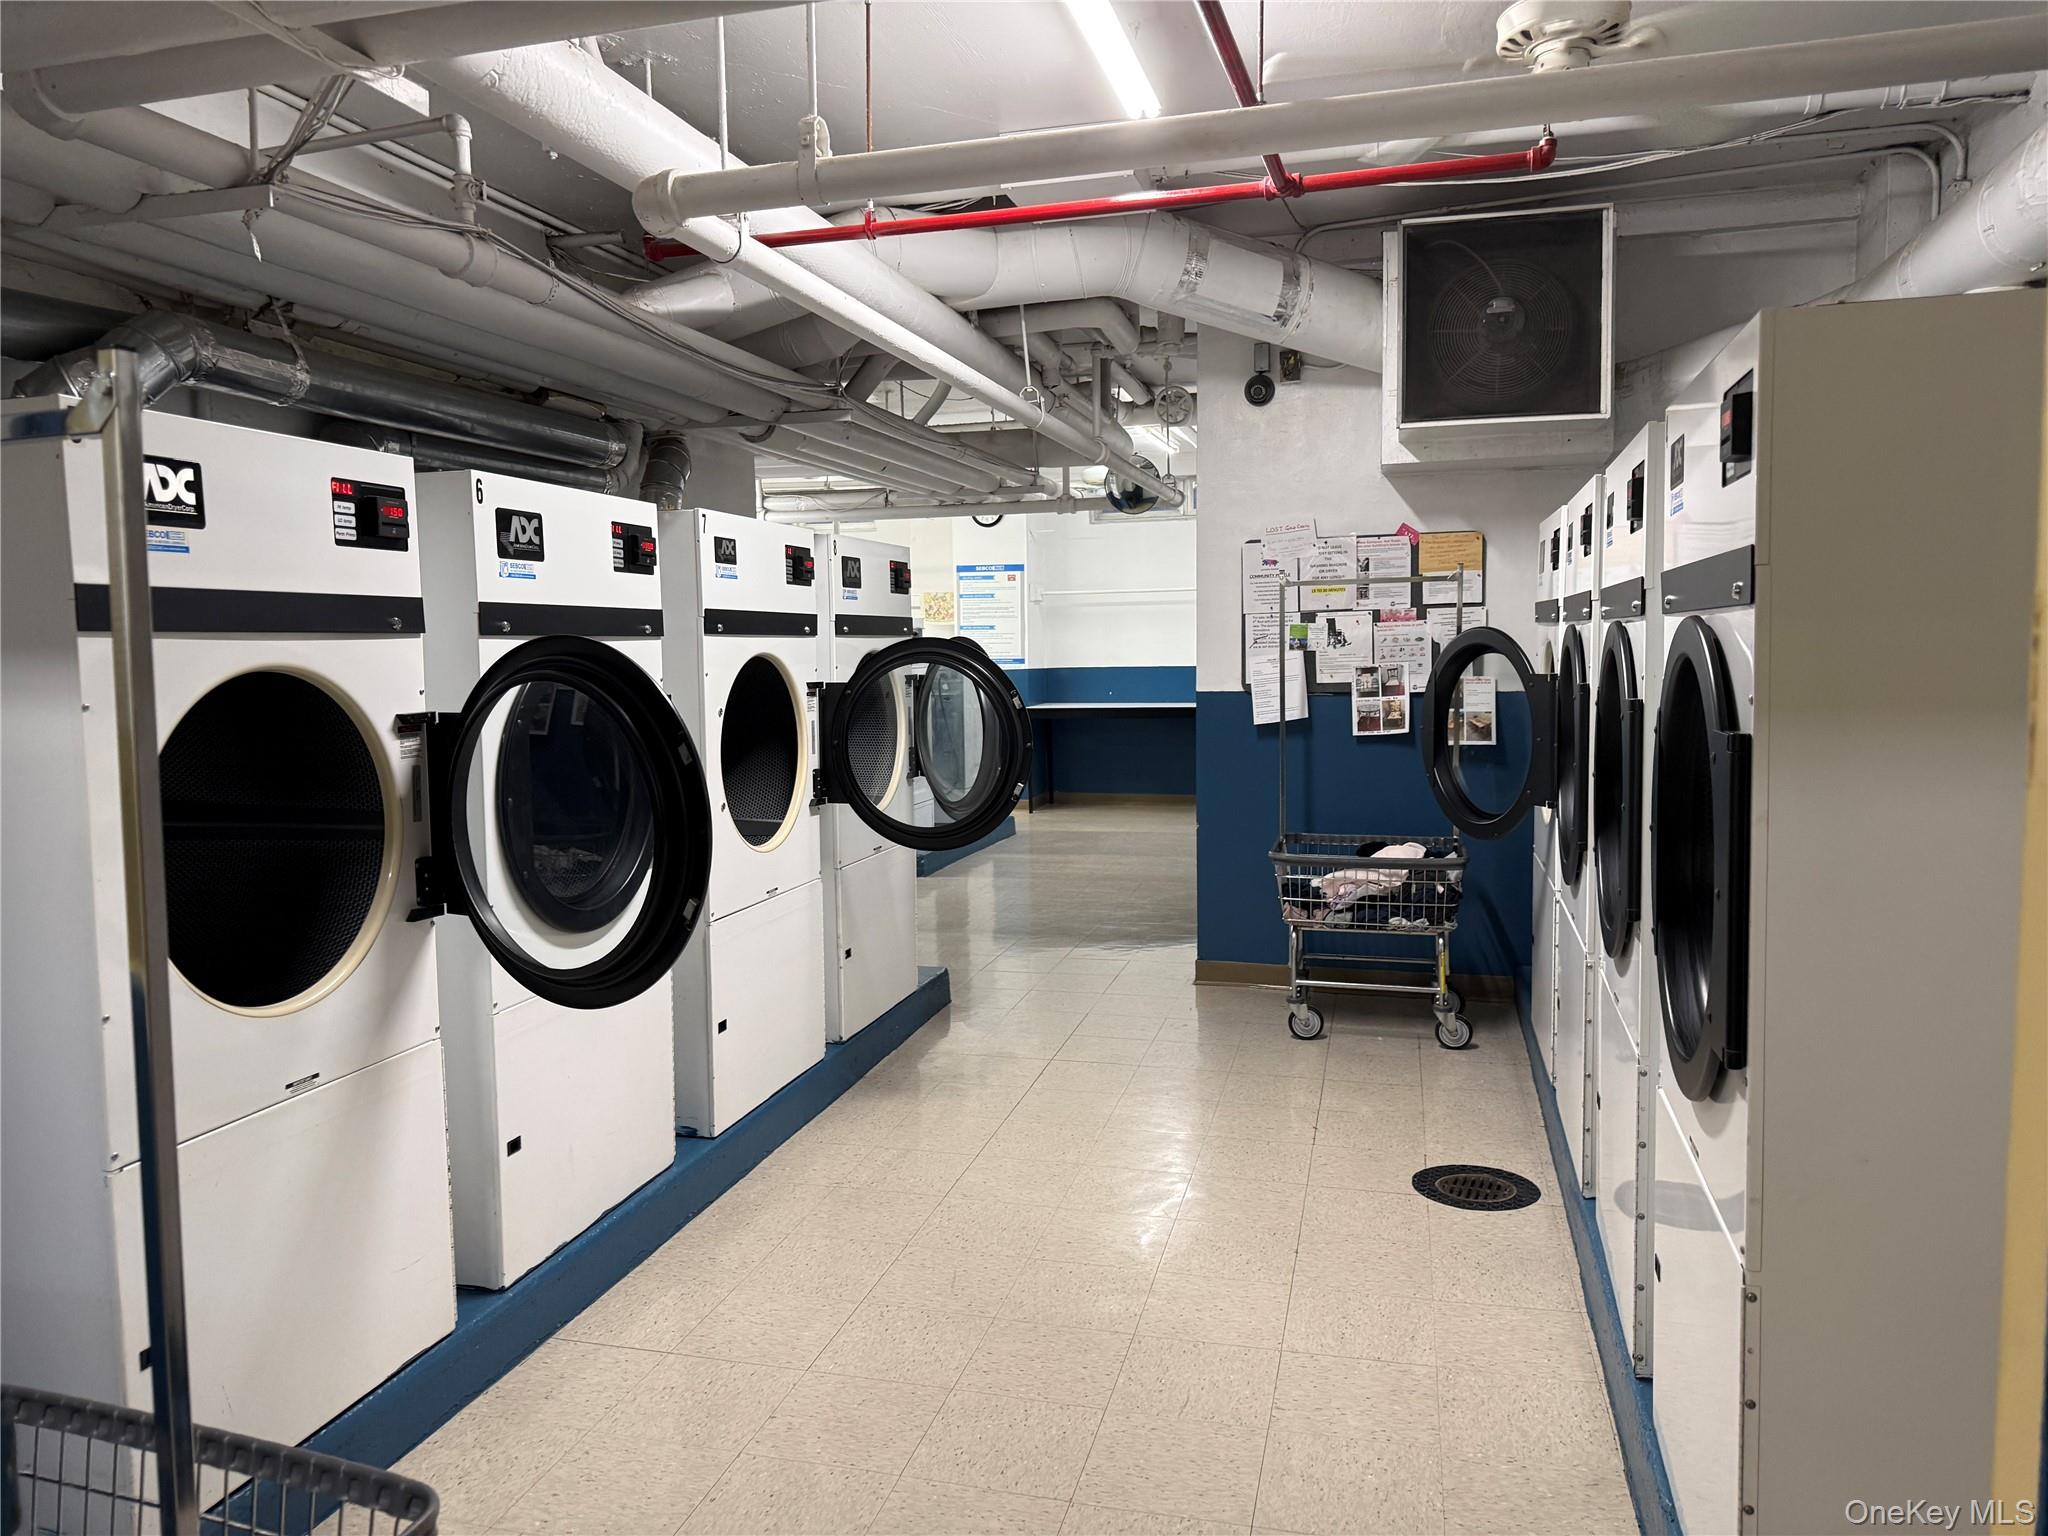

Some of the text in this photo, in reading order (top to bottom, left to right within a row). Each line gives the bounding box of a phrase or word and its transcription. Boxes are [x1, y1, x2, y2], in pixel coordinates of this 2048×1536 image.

[144, 462, 197, 506] ADC
[331, 481, 353, 495] FILL
[475, 478, 483, 505] 6
[509, 515, 540, 545] ADC
[701, 514, 706, 534] 7
